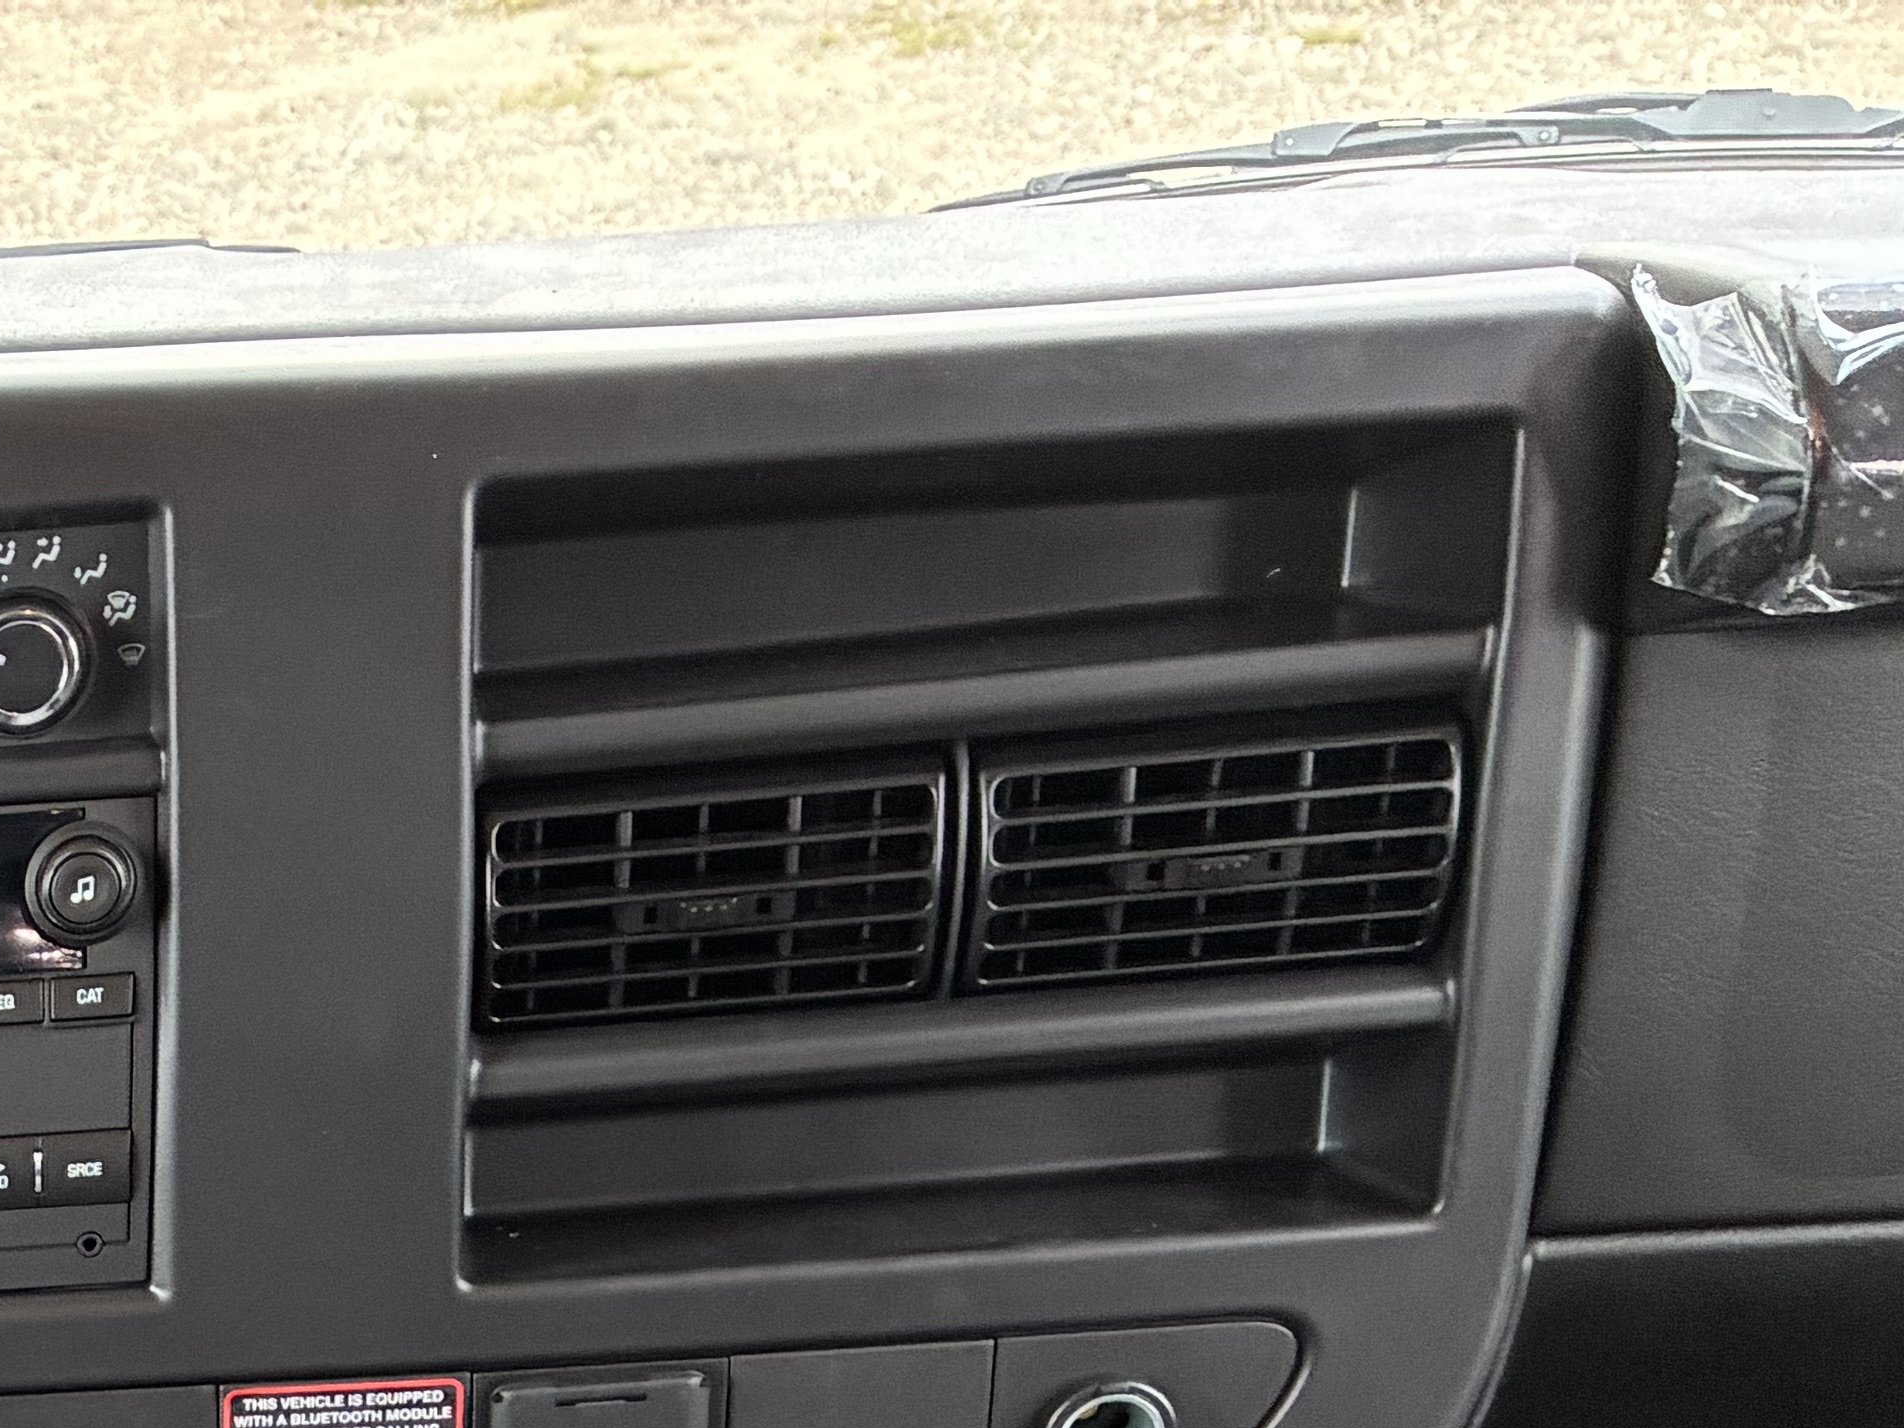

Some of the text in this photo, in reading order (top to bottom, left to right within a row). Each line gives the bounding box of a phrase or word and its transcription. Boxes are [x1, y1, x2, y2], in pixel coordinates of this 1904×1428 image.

[76, 987, 104, 1005] CAT
[67, 1161, 104, 1179] SRCE
[243, 1389, 445, 1412] THIS VEHICLE IS EQUIPPED
[233, 1406, 453, 1428] WITH A BLUETOOTH MODULE
